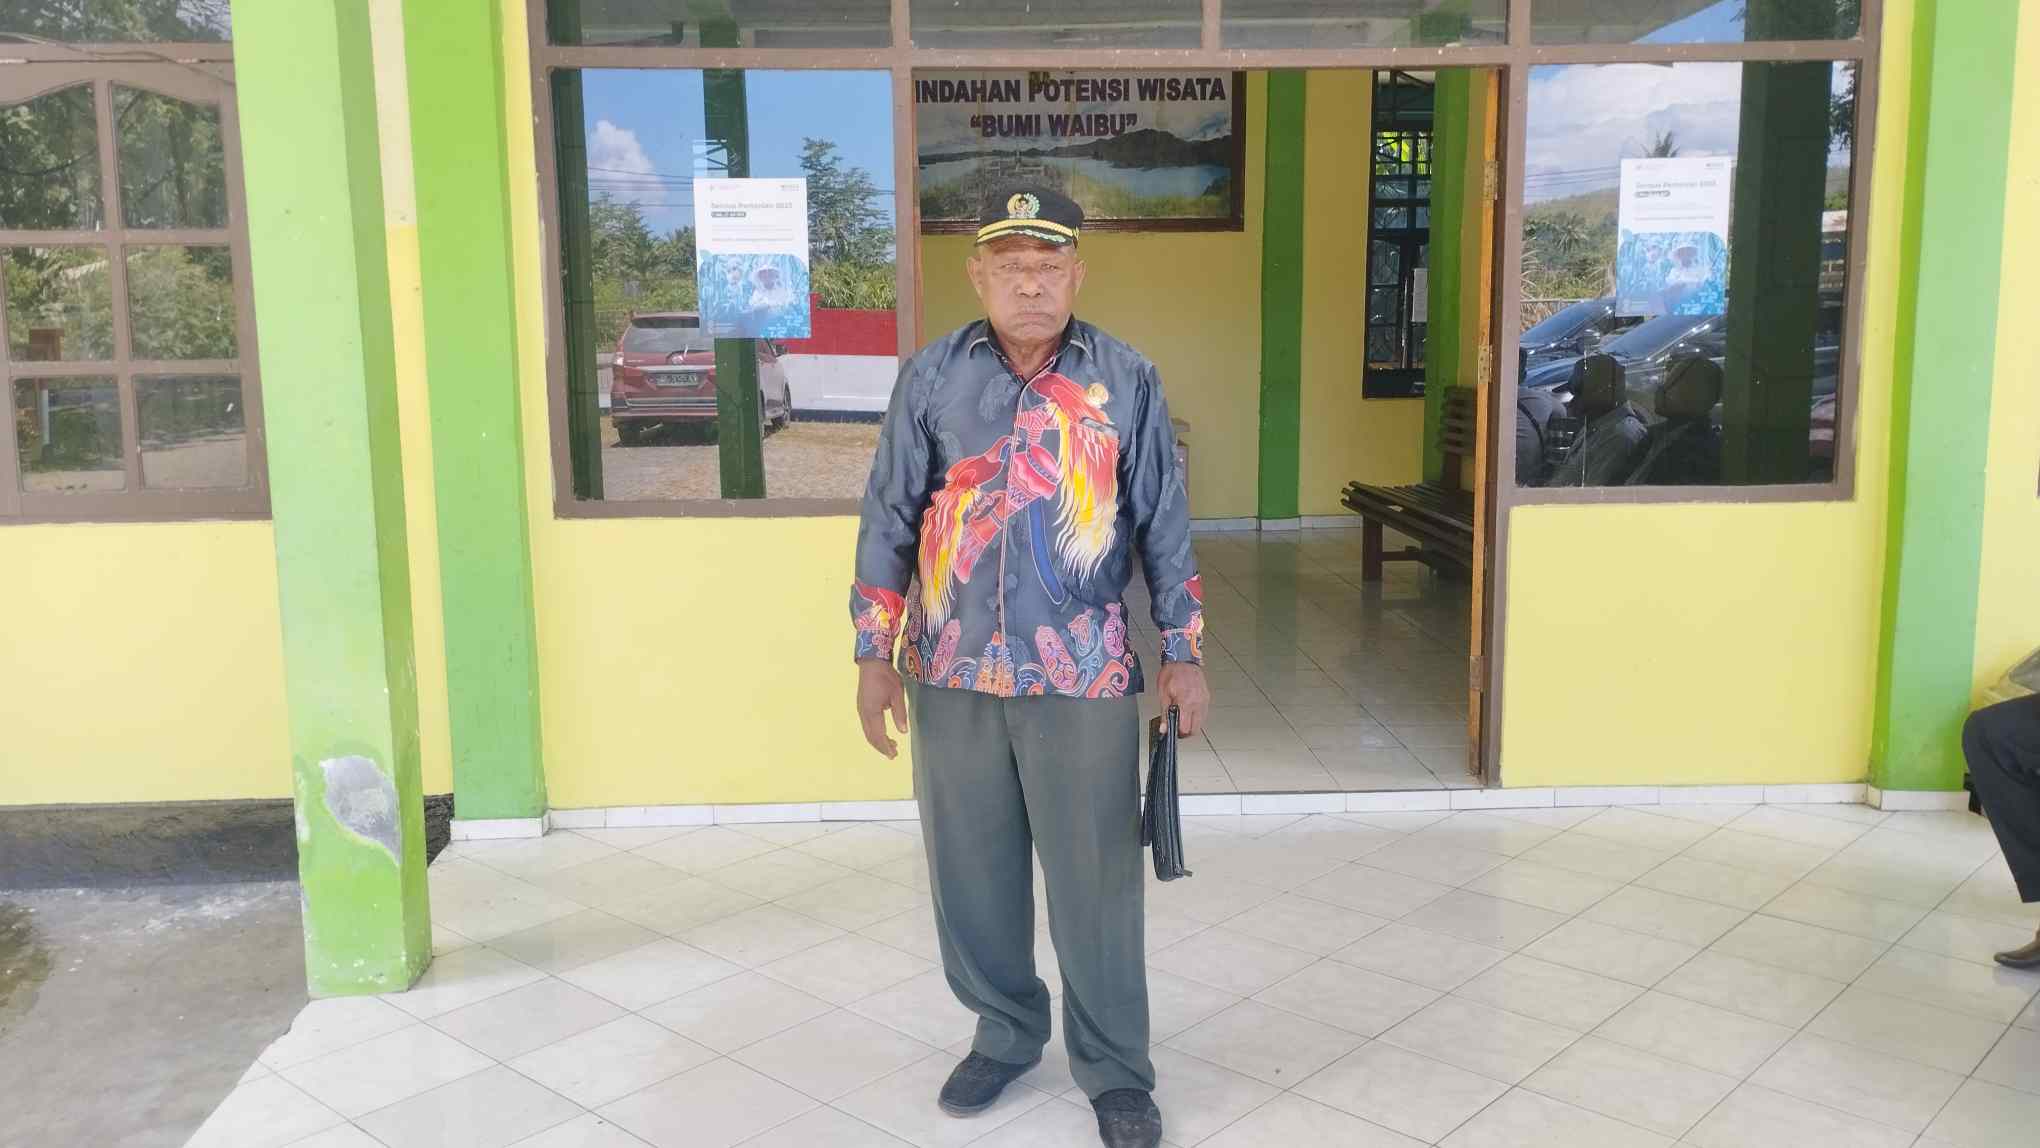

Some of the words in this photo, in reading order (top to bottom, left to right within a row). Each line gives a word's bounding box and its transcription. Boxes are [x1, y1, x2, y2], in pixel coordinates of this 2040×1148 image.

[915, 79, 1021, 103] INDAHAN
[1029, 78, 1130, 102] POTENSI
[1137, 77, 1226, 101] WISATA
[970, 114, 1041, 137] “BUMI
[1048, 113, 1138, 136] WAIBU”
